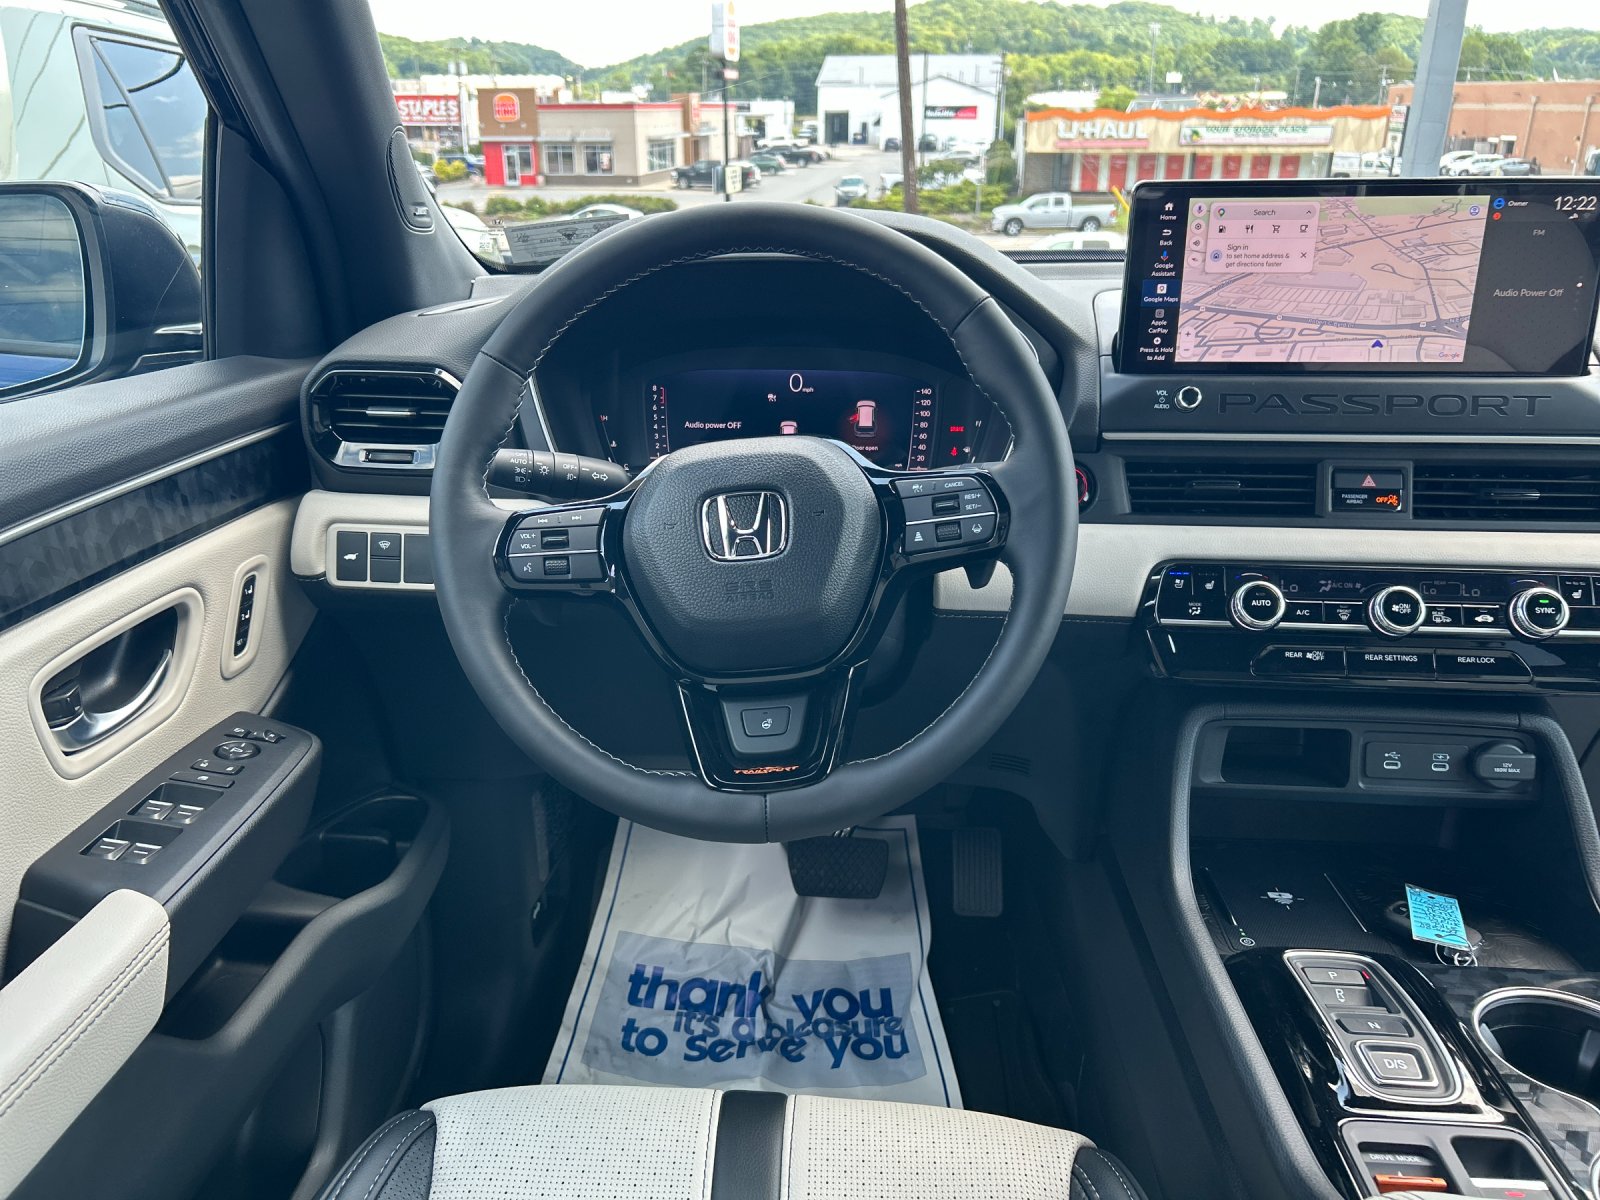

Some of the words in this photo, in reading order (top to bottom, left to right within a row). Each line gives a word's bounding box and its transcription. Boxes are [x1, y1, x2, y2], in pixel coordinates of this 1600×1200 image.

[398, 100, 458, 117] STAPLES
[1508, 199, 1528, 207] Owner
[1554, 195, 1597, 211] 12:22
[1253, 208, 1276, 216] Search
[1532, 228, 1545, 236] FM
[1227, 244, 1243, 252] Sign
[1154, 262, 1174, 270] Google
[1494, 288, 1518, 297] Audio
[1520, 289, 1547, 297] Power
[1549, 288, 1564, 297] Off
[789, 373, 803, 392] 0
[1218, 394, 1552, 417] PASSPORT
[684, 421, 704, 429] Audio
[705, 422, 726, 430] power
[727, 421, 742, 429] OFF
[734, 765, 799, 775] TRAILSPORT
[1328, 971, 1337, 979] P
[627, 963, 770, 1019] thank
[792, 985, 893, 1023] you
[1336, 989, 1344, 998] R
[673, 1011, 720, 1037] it's
[732, 1016, 756, 1041] a
[766, 1014, 902, 1040] pleasure
[621, 1018, 668, 1056] to
[683, 1033, 807, 1063] serve
[825, 1032, 910, 1069] you
[1384, 1059, 1407, 1069] D/S
[1396, 1154, 1422, 1162] MODE
